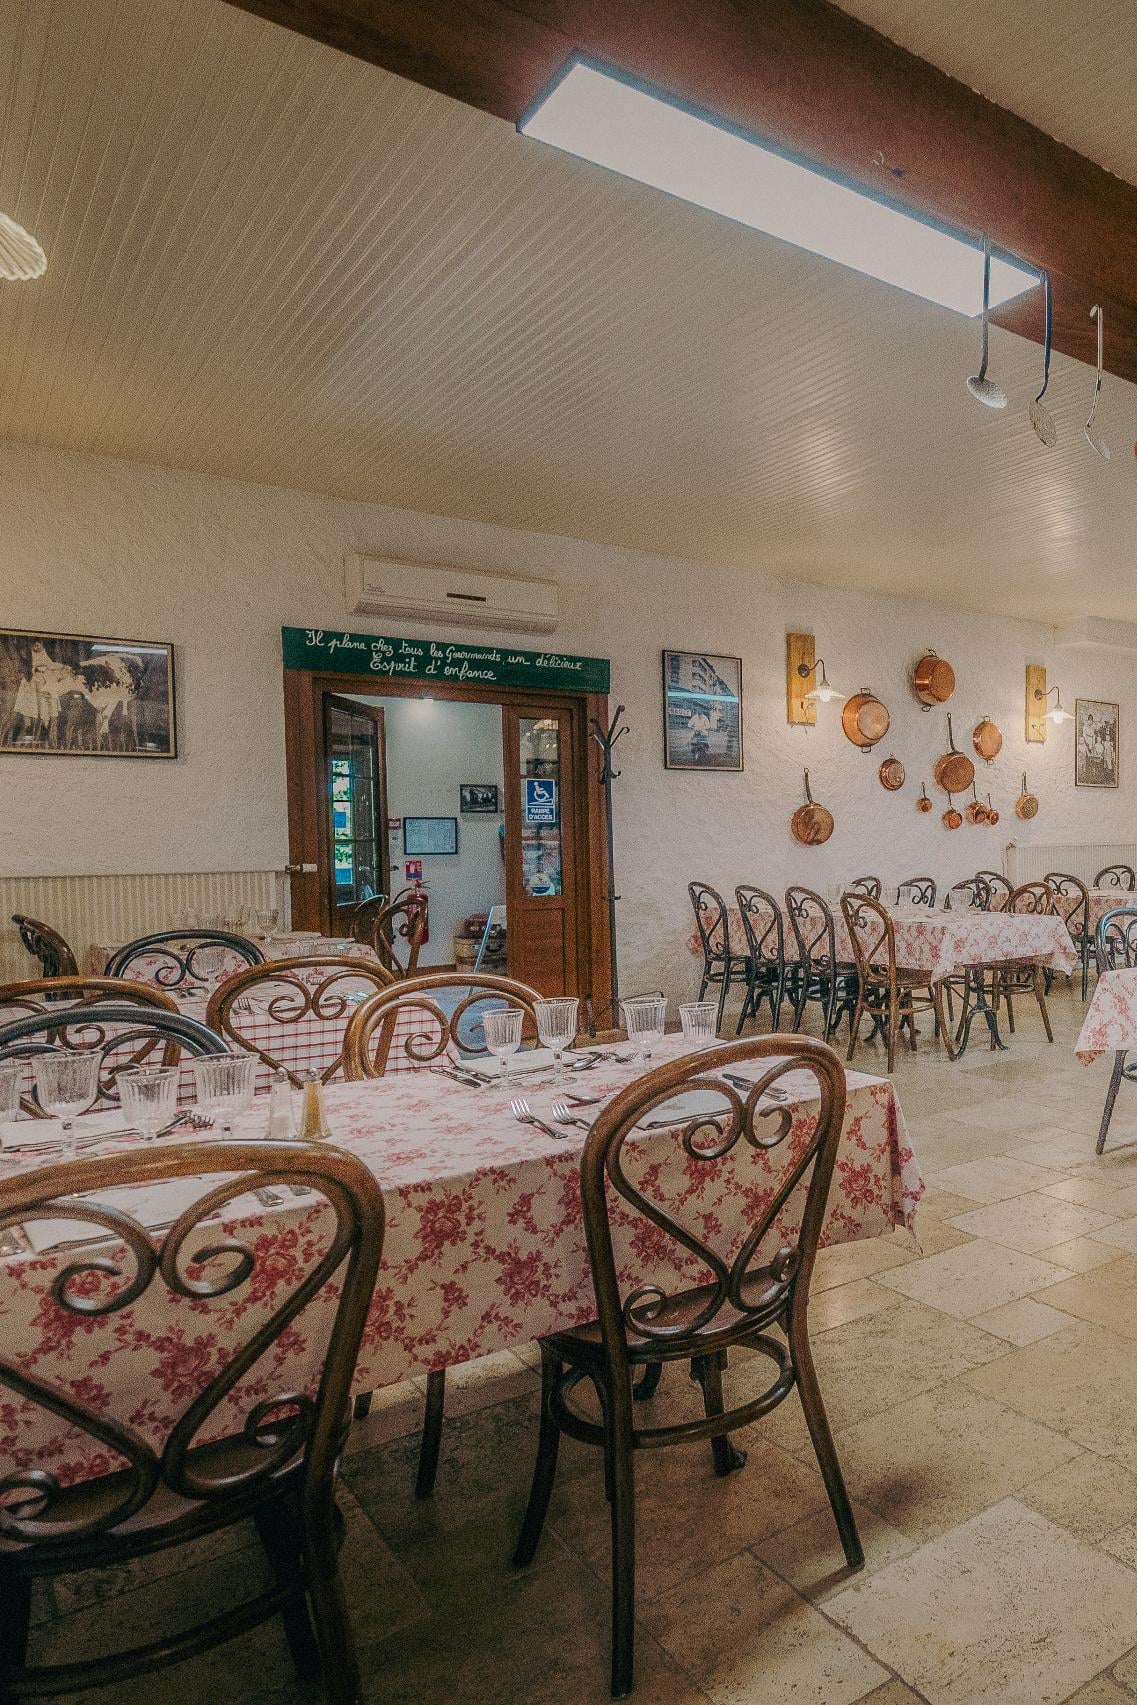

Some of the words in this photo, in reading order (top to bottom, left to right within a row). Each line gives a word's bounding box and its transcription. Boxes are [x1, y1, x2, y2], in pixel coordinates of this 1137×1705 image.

[305, 630, 324, 646] Il
[328, 633, 367, 654] plane
[371, 639, 394, 656] chez
[399, 640, 424, 656] tous
[430, 643, 443, 657] les
[506, 655, 531, 665] un
[535, 654, 582, 670] délicieux
[370, 652, 417, 675] Esprit
